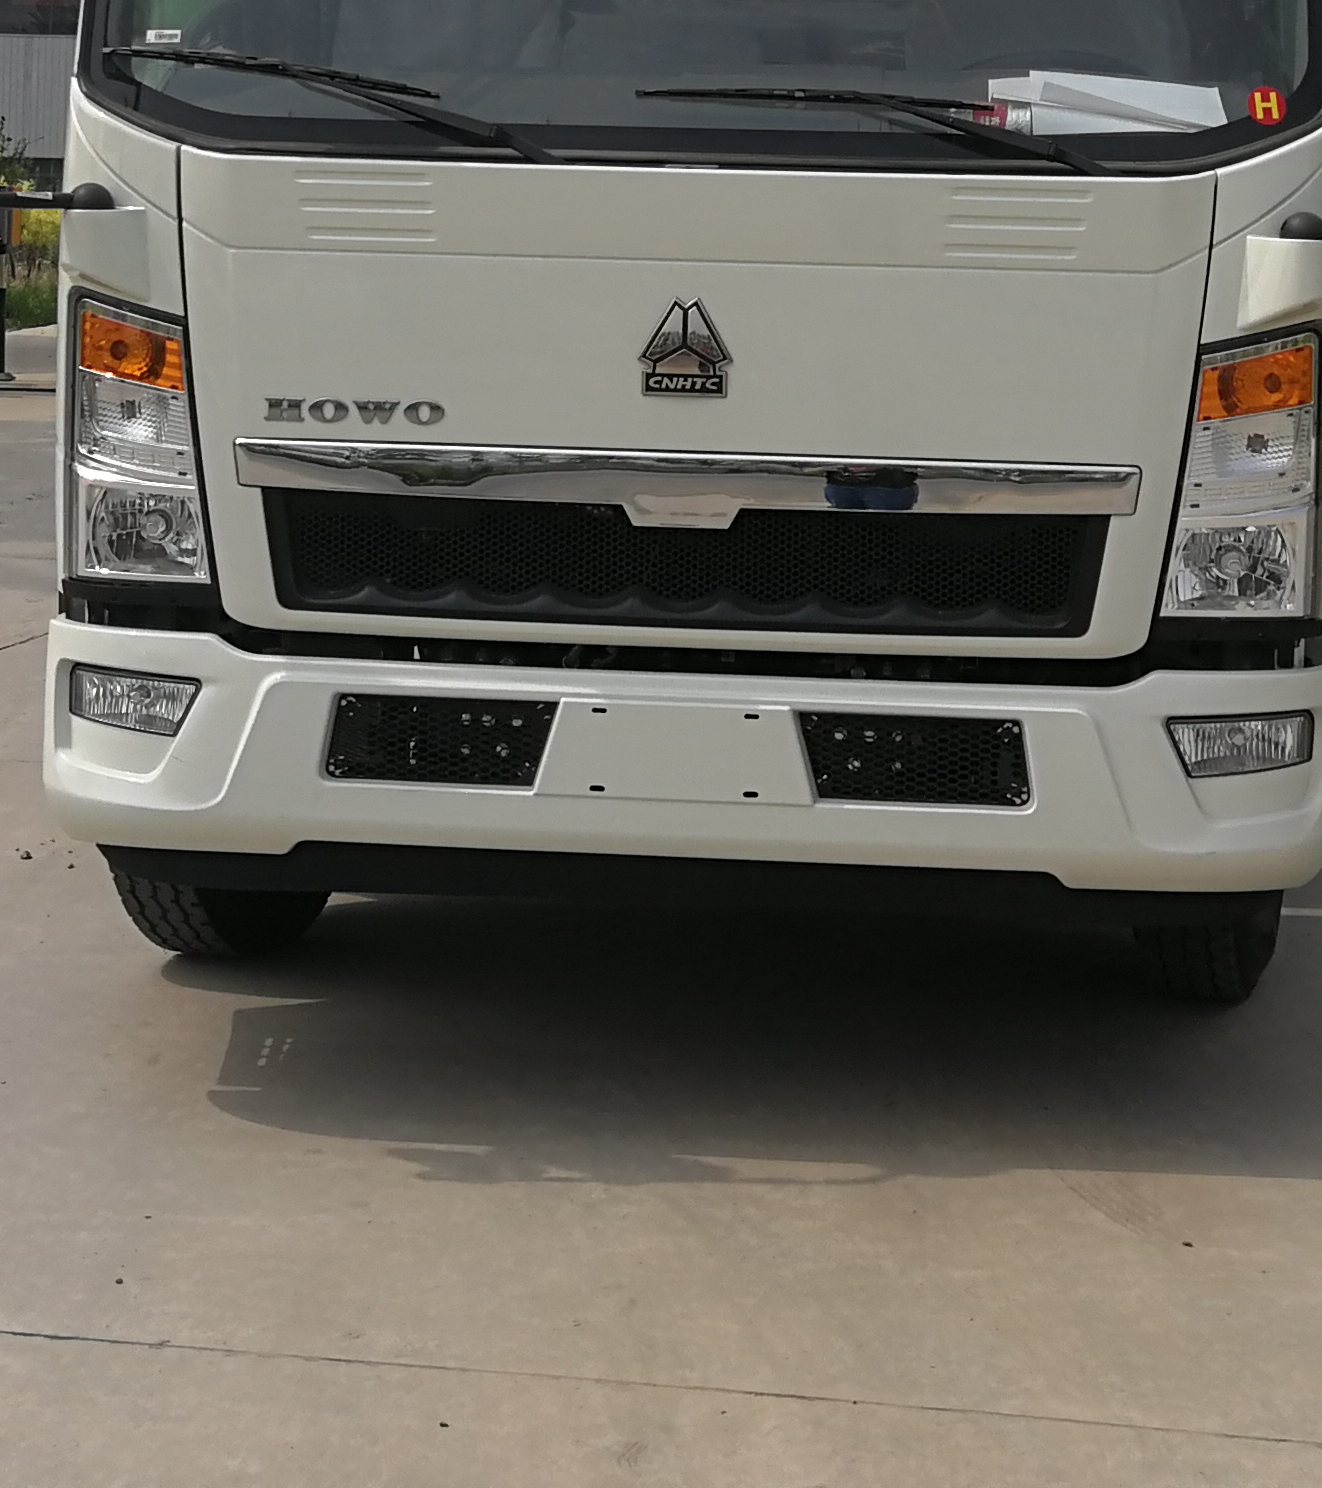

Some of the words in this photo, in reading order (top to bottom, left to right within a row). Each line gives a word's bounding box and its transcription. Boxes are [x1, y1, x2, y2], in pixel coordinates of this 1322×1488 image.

[1253, 91, 1280, 120] H
[648, 376, 720, 390] CNHTC
[263, 396, 445, 426] HOWO
